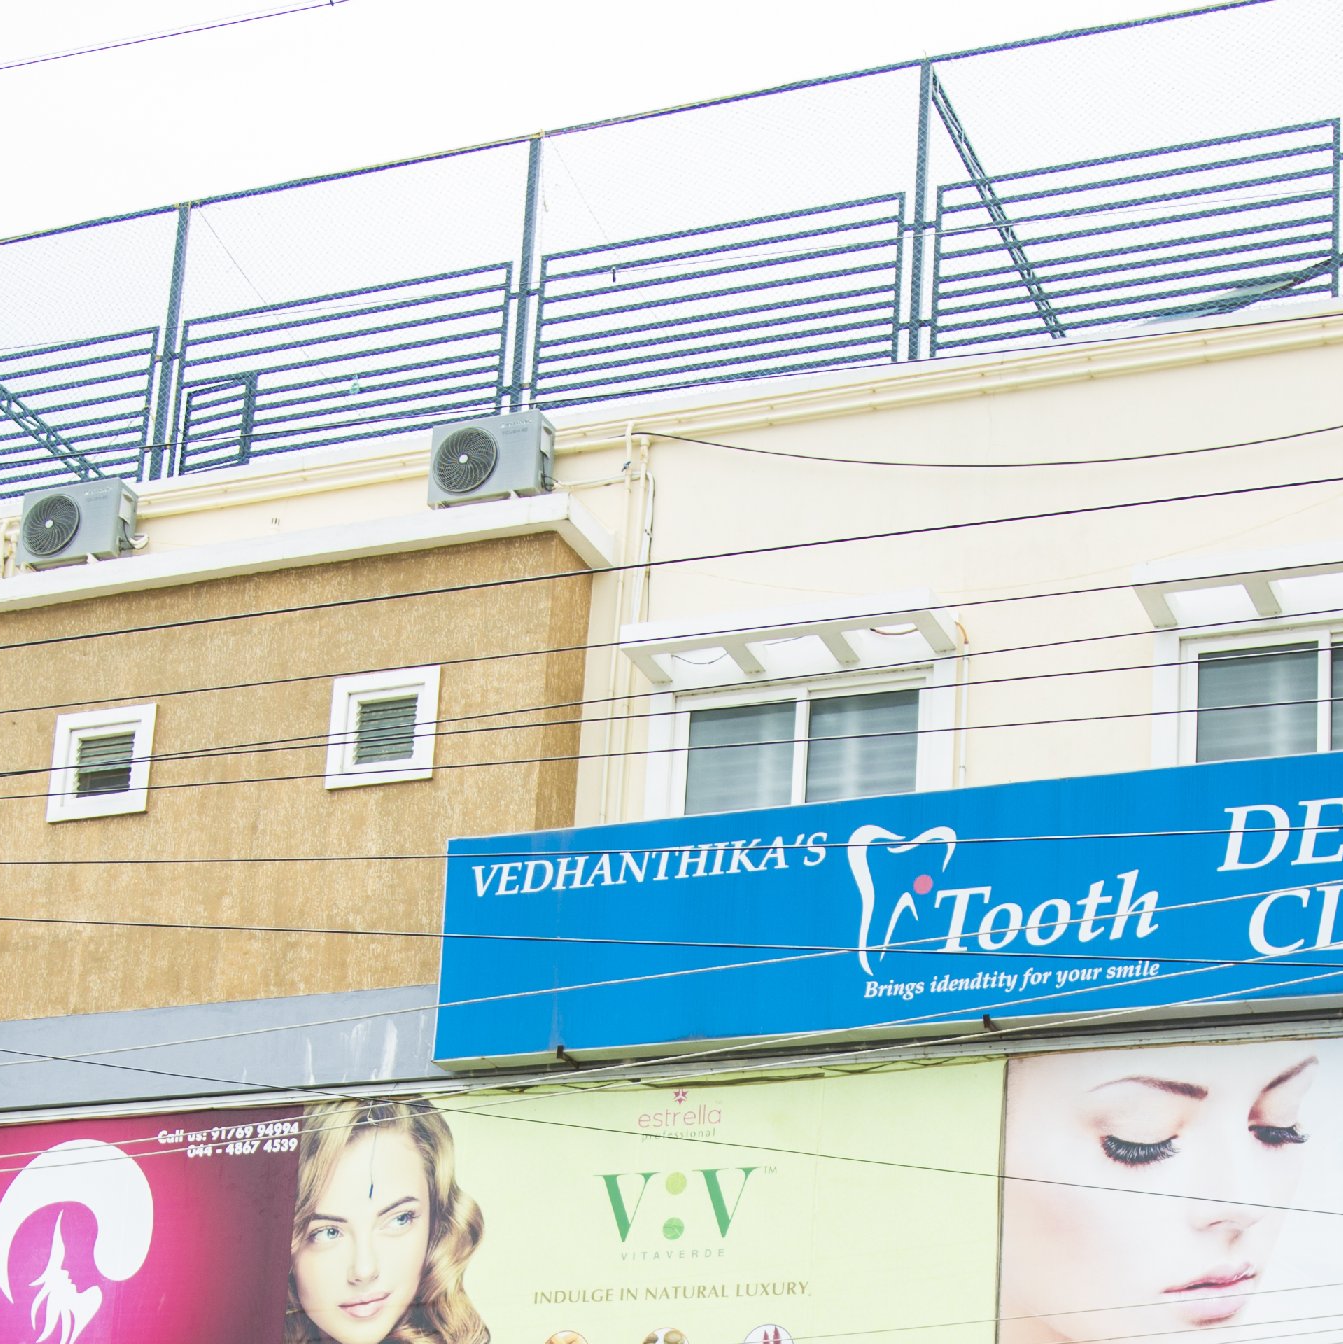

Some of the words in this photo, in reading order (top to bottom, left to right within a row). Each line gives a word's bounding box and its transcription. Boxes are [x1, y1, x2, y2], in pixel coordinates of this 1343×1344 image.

[470, 830, 828, 898] VEDHANTHIKA'S
[930, 868, 1161, 955] Tooth
[864, 977, 924, 1001] Brings
[928, 970, 1017, 999] idendtity
[1020, 968, 1053, 993] for
[1055, 967, 1103, 990] your
[1106, 960, 1161, 982] smile
[637, 1104, 723, 1128] estrella
[157, 1129, 184, 1144] Call
[211, 1125, 254, 1141] 91769
[257, 1121, 299, 1138] 94994
[641, 1127, 717, 1143] professional
[187, 1143, 213, 1158] 044
[225, 1140, 261, 1156] 4867
[263, 1138, 299, 1153] 4539
[620, 1248, 725, 1262] VITAVERDE
[534, 1288, 614, 1305] INDULGE
[619, 1287, 638, 1301] IN
[644, 1284, 730, 1300] NATURAL
